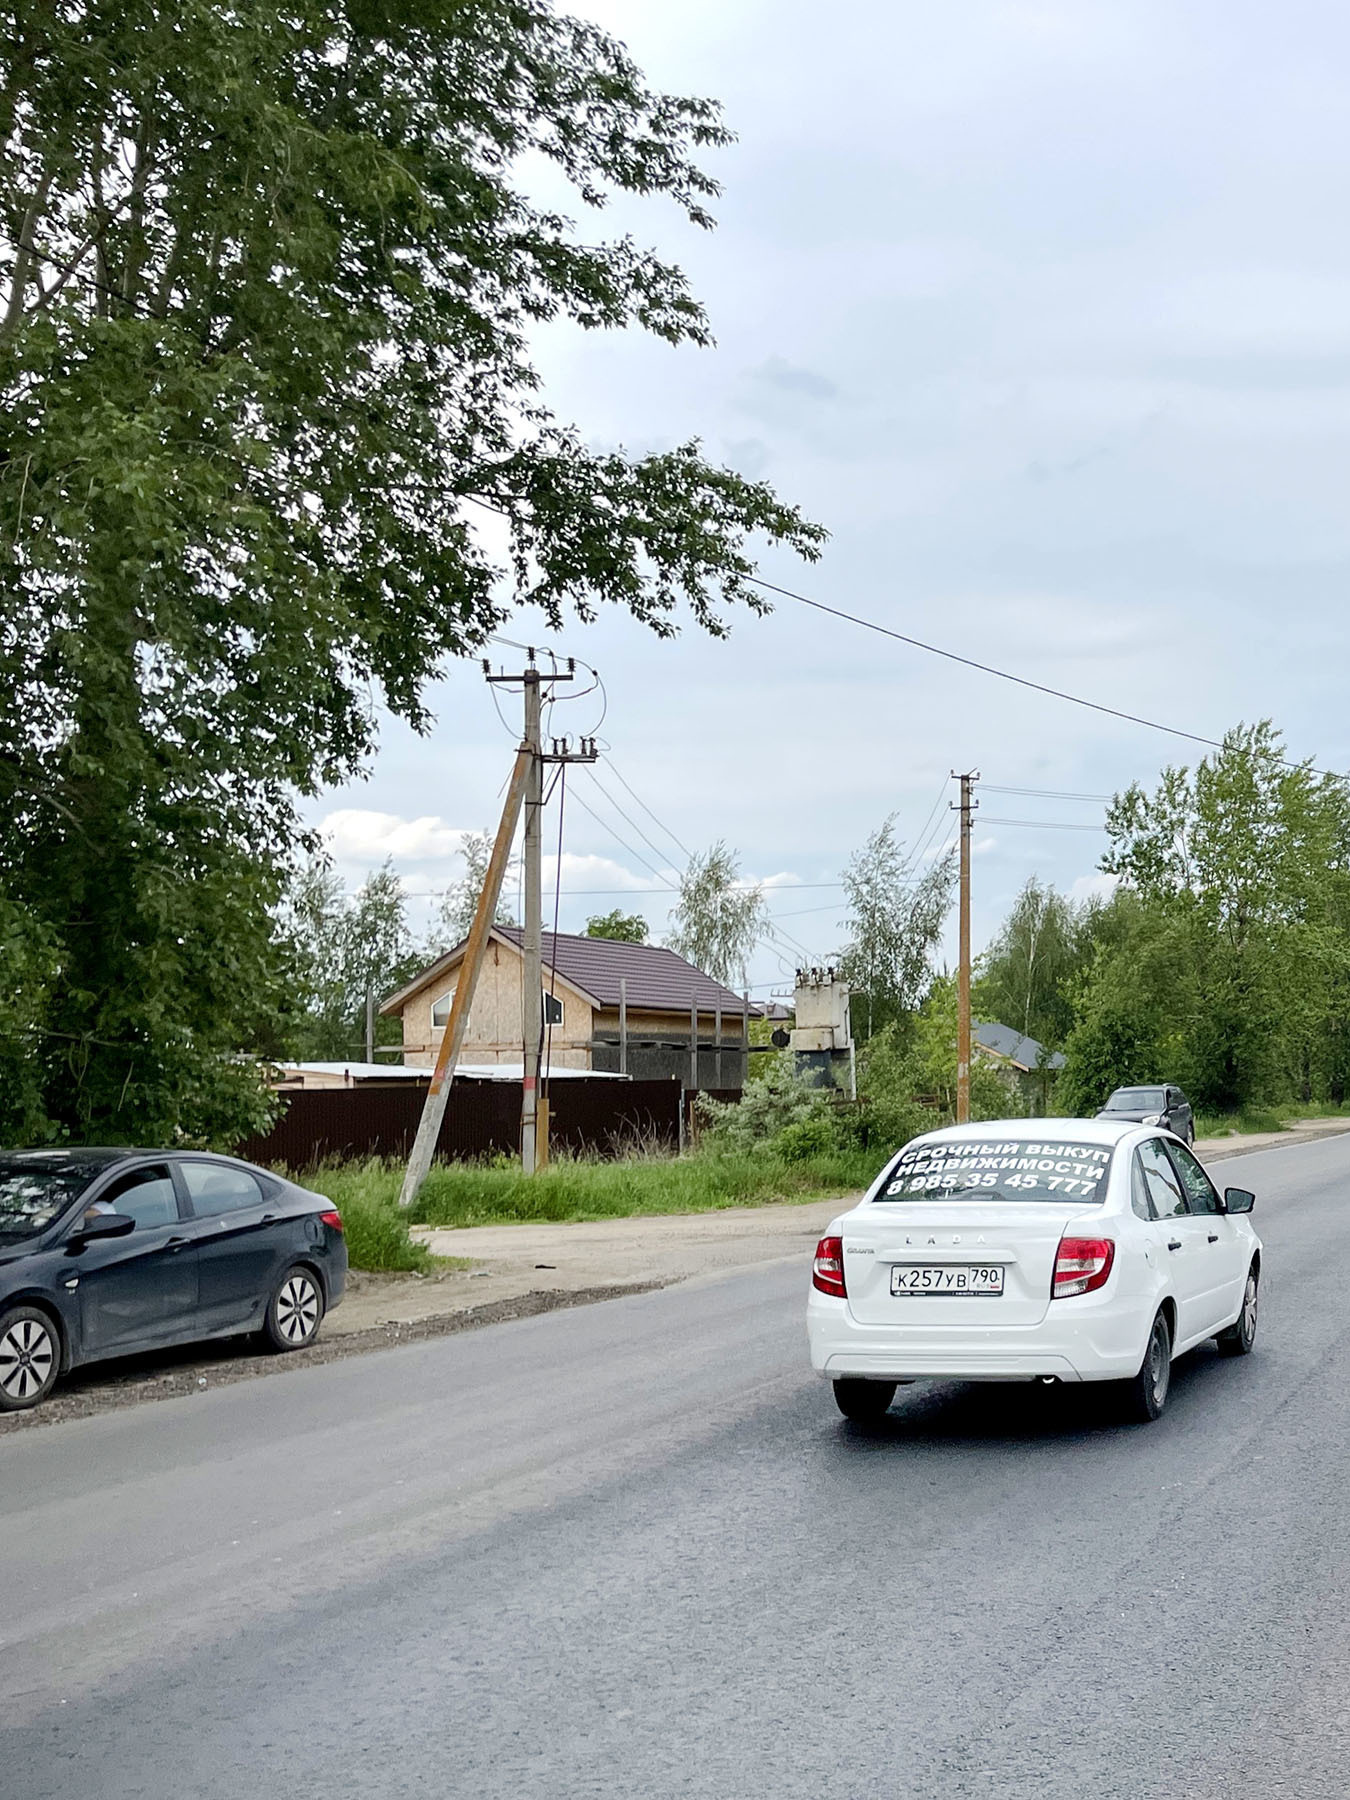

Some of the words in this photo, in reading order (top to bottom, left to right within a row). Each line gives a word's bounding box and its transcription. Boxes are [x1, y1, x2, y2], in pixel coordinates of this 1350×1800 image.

[901, 1142, 1020, 1165] СРОЧНЫЙ
[1025, 1144, 1111, 1164] ВЫКУП
[895, 1157, 1105, 1180] НЕДВИЖИМОСТИ
[886, 1179, 904, 1196] 8
[909, 1174, 960, 1192] 985
[964, 1172, 1000, 1188] 35
[1003, 1173, 1040, 1189] 45
[1047, 1175, 1098, 1197] 777
[905, 1234, 987, 1245] LADA
[971, 1268, 999, 1283] 790
